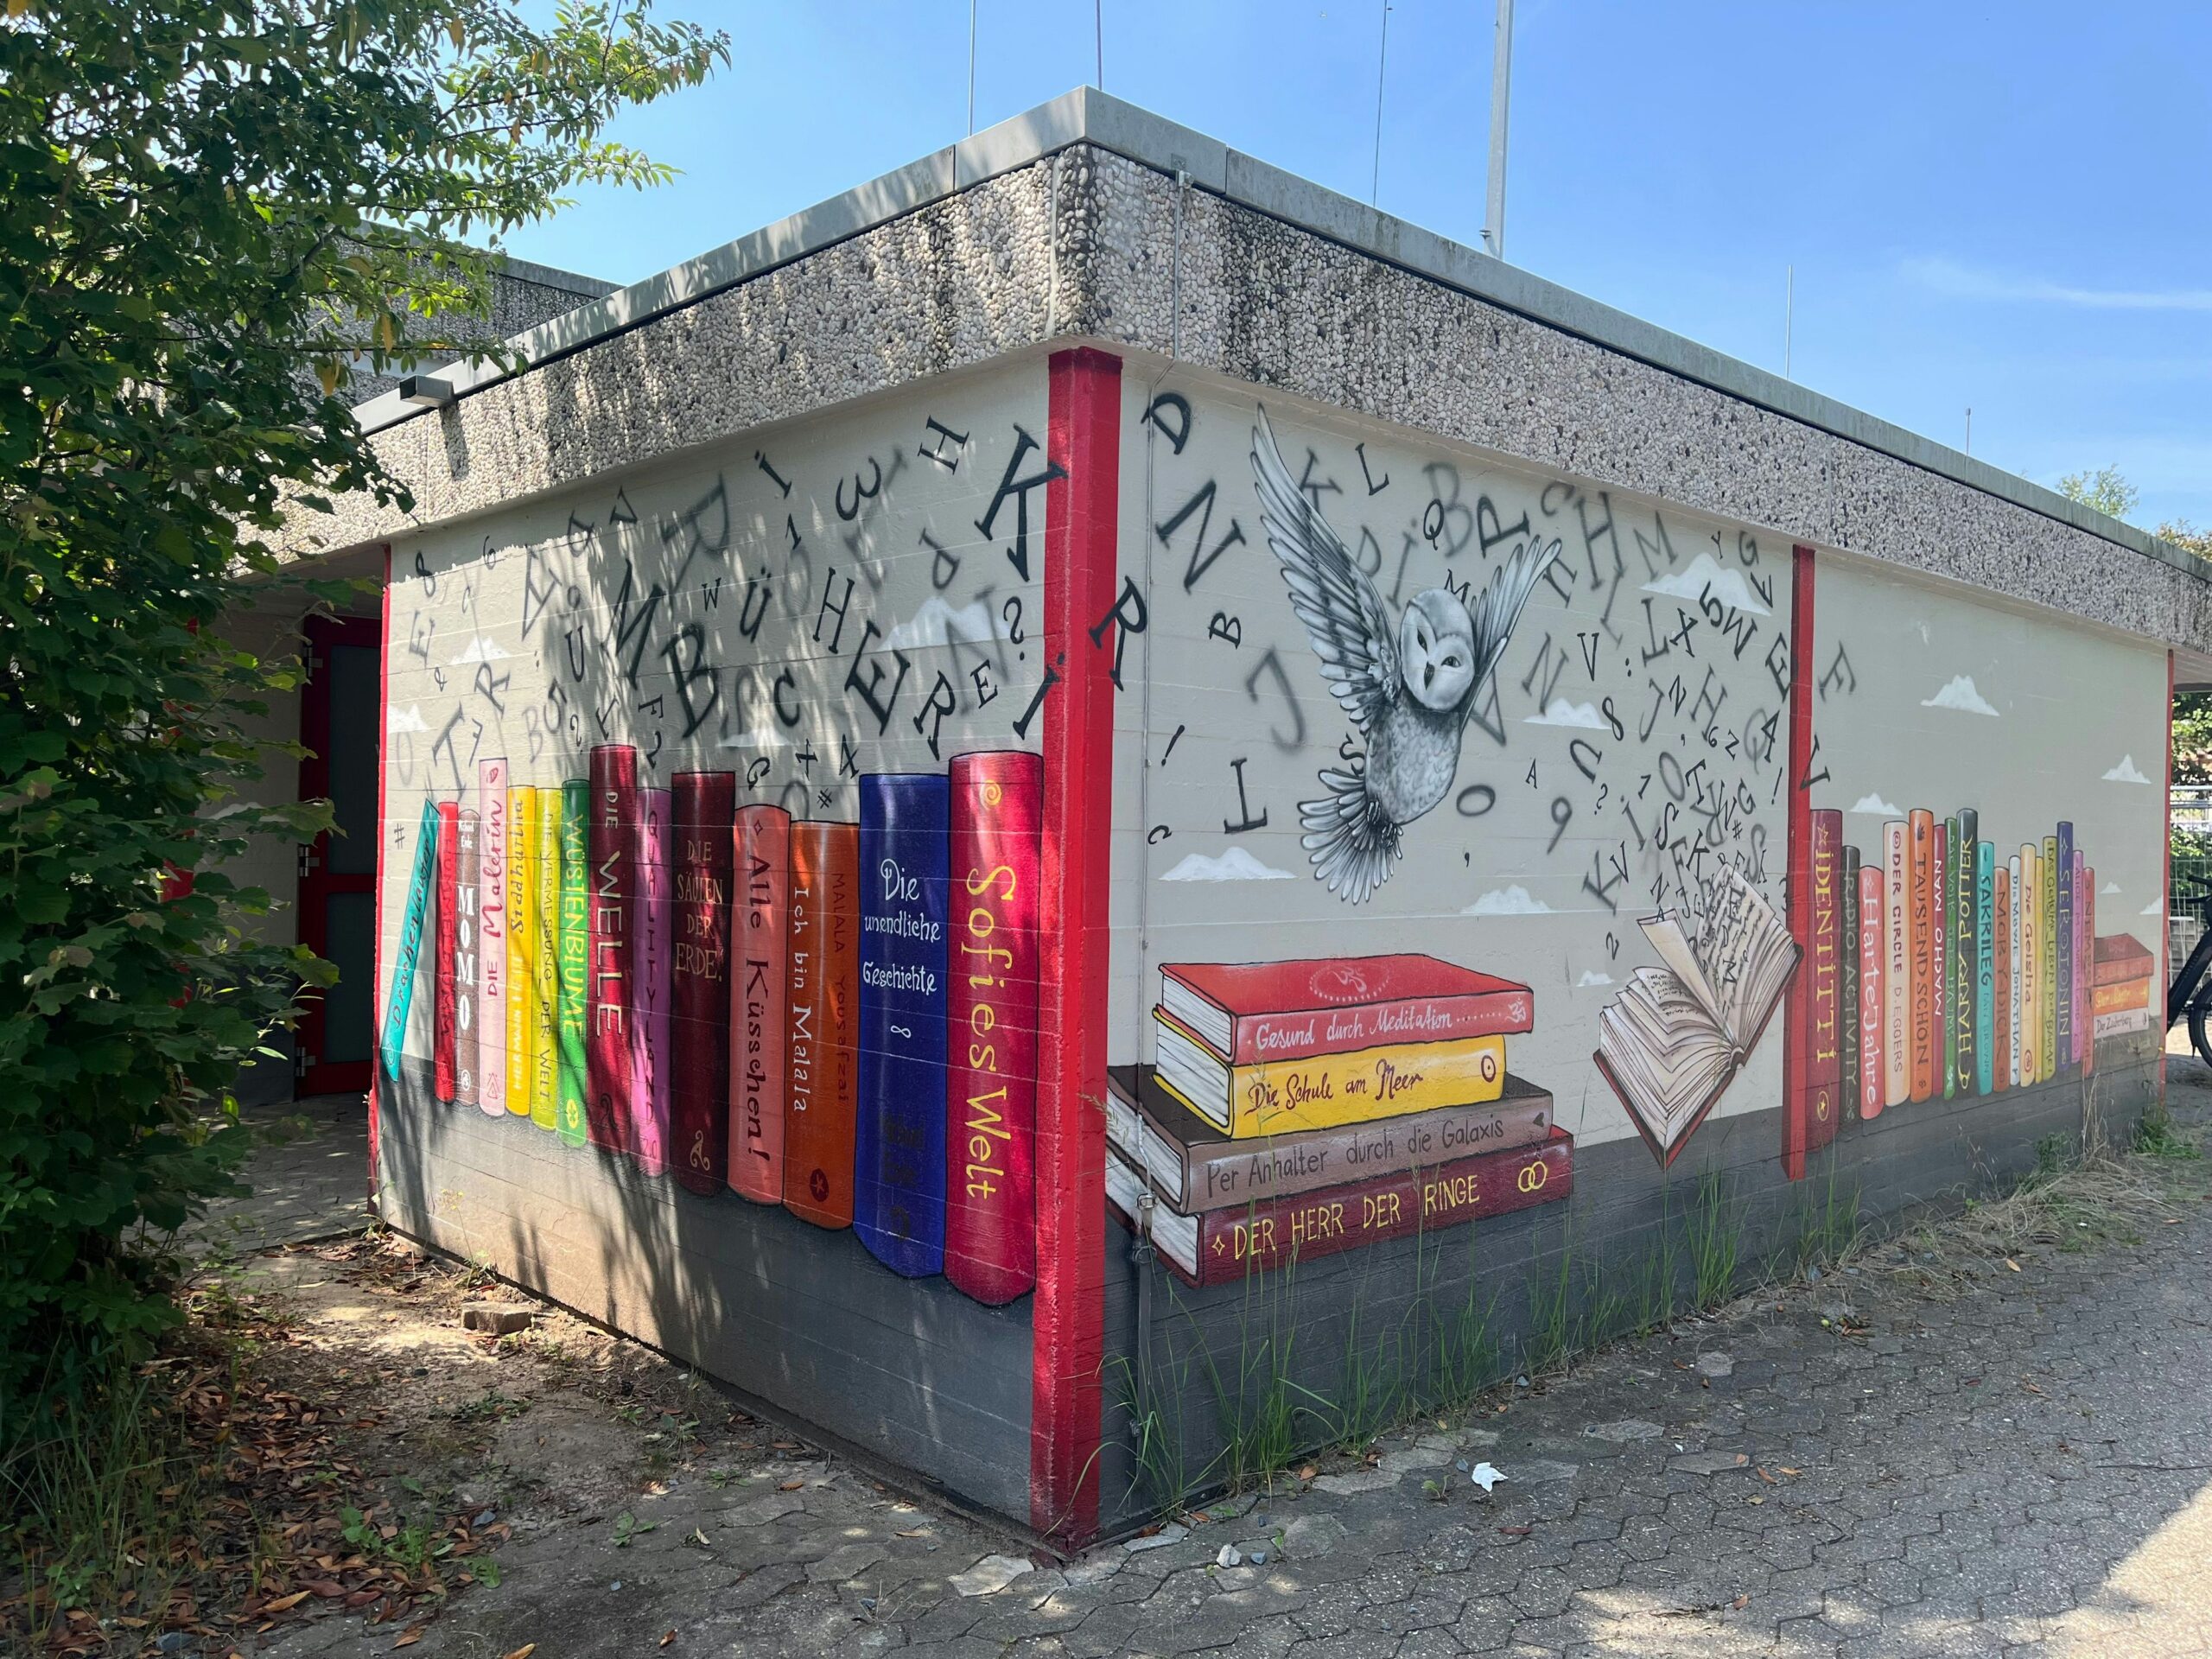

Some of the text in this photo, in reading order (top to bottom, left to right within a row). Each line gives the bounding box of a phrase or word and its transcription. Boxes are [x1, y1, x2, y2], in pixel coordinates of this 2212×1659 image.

[974, 423, 1069, 582] K
[481, 800, 503, 996] DIE Malerin
[509, 800, 524, 934] Siddhartha
[677, 871, 723, 905] SÄULEN
[687, 840, 712, 864] DIE
[880, 858, 920, 901] Die
[1892, 853, 1902, 895] DER
[458, 886, 474, 1030] MOMO
[539, 813, 555, 1101] DIE VERMESSUNG DER WELT
[596, 791, 623, 1037] DIE WELLE
[687, 913, 715, 939] DER
[832, 873, 846, 953] MALALA
[864, 913, 942, 942] unendliche
[1892, 906, 1902, 975] CIRCLE
[1934, 859, 1943, 1017] MACHO MAN
[1957, 832, 1974, 1056] HARRY POTTER
[1980, 874, 1992, 987] SAKRILEG
[2058, 869, 2070, 1035] SEROTONIN
[745, 854, 772, 1163] Alle Küsschen!
[792, 887, 812, 1113] Ich bin Malala
[862, 961, 938, 997] Geschichte
[1843, 874, 1857, 1089] RADIO ACTIVITY
[2024, 923, 2033, 1005] Geisha
[962, 865, 1017, 1201] Sofies Welt
[1255, 1008, 1453, 1051] Gesund durch Meditation
[1244, 1058, 1423, 1116] Die Schule am Meer
[1207, 1115, 1504, 1198] Per Anhalter durch die Galaxis
[1234, 1175, 1481, 1261] DER HERR DER RINGE
